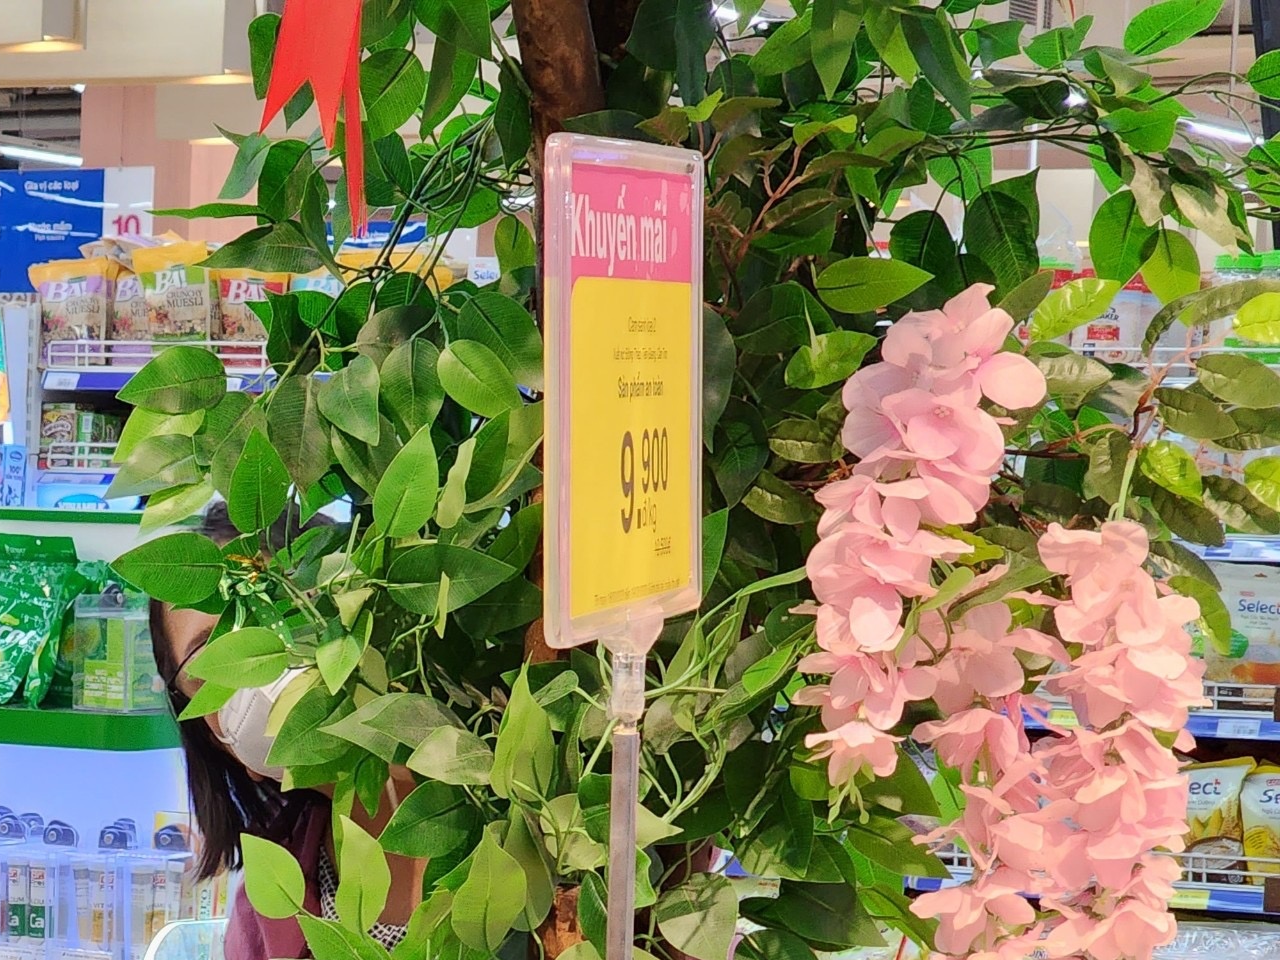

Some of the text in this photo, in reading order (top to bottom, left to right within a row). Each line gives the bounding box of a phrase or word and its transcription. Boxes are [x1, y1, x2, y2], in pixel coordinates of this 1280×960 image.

[112, 214, 141, 236] 10
[571, 183, 667, 277] Khuyến mãi
[166, 297, 204, 308] MUESLI
